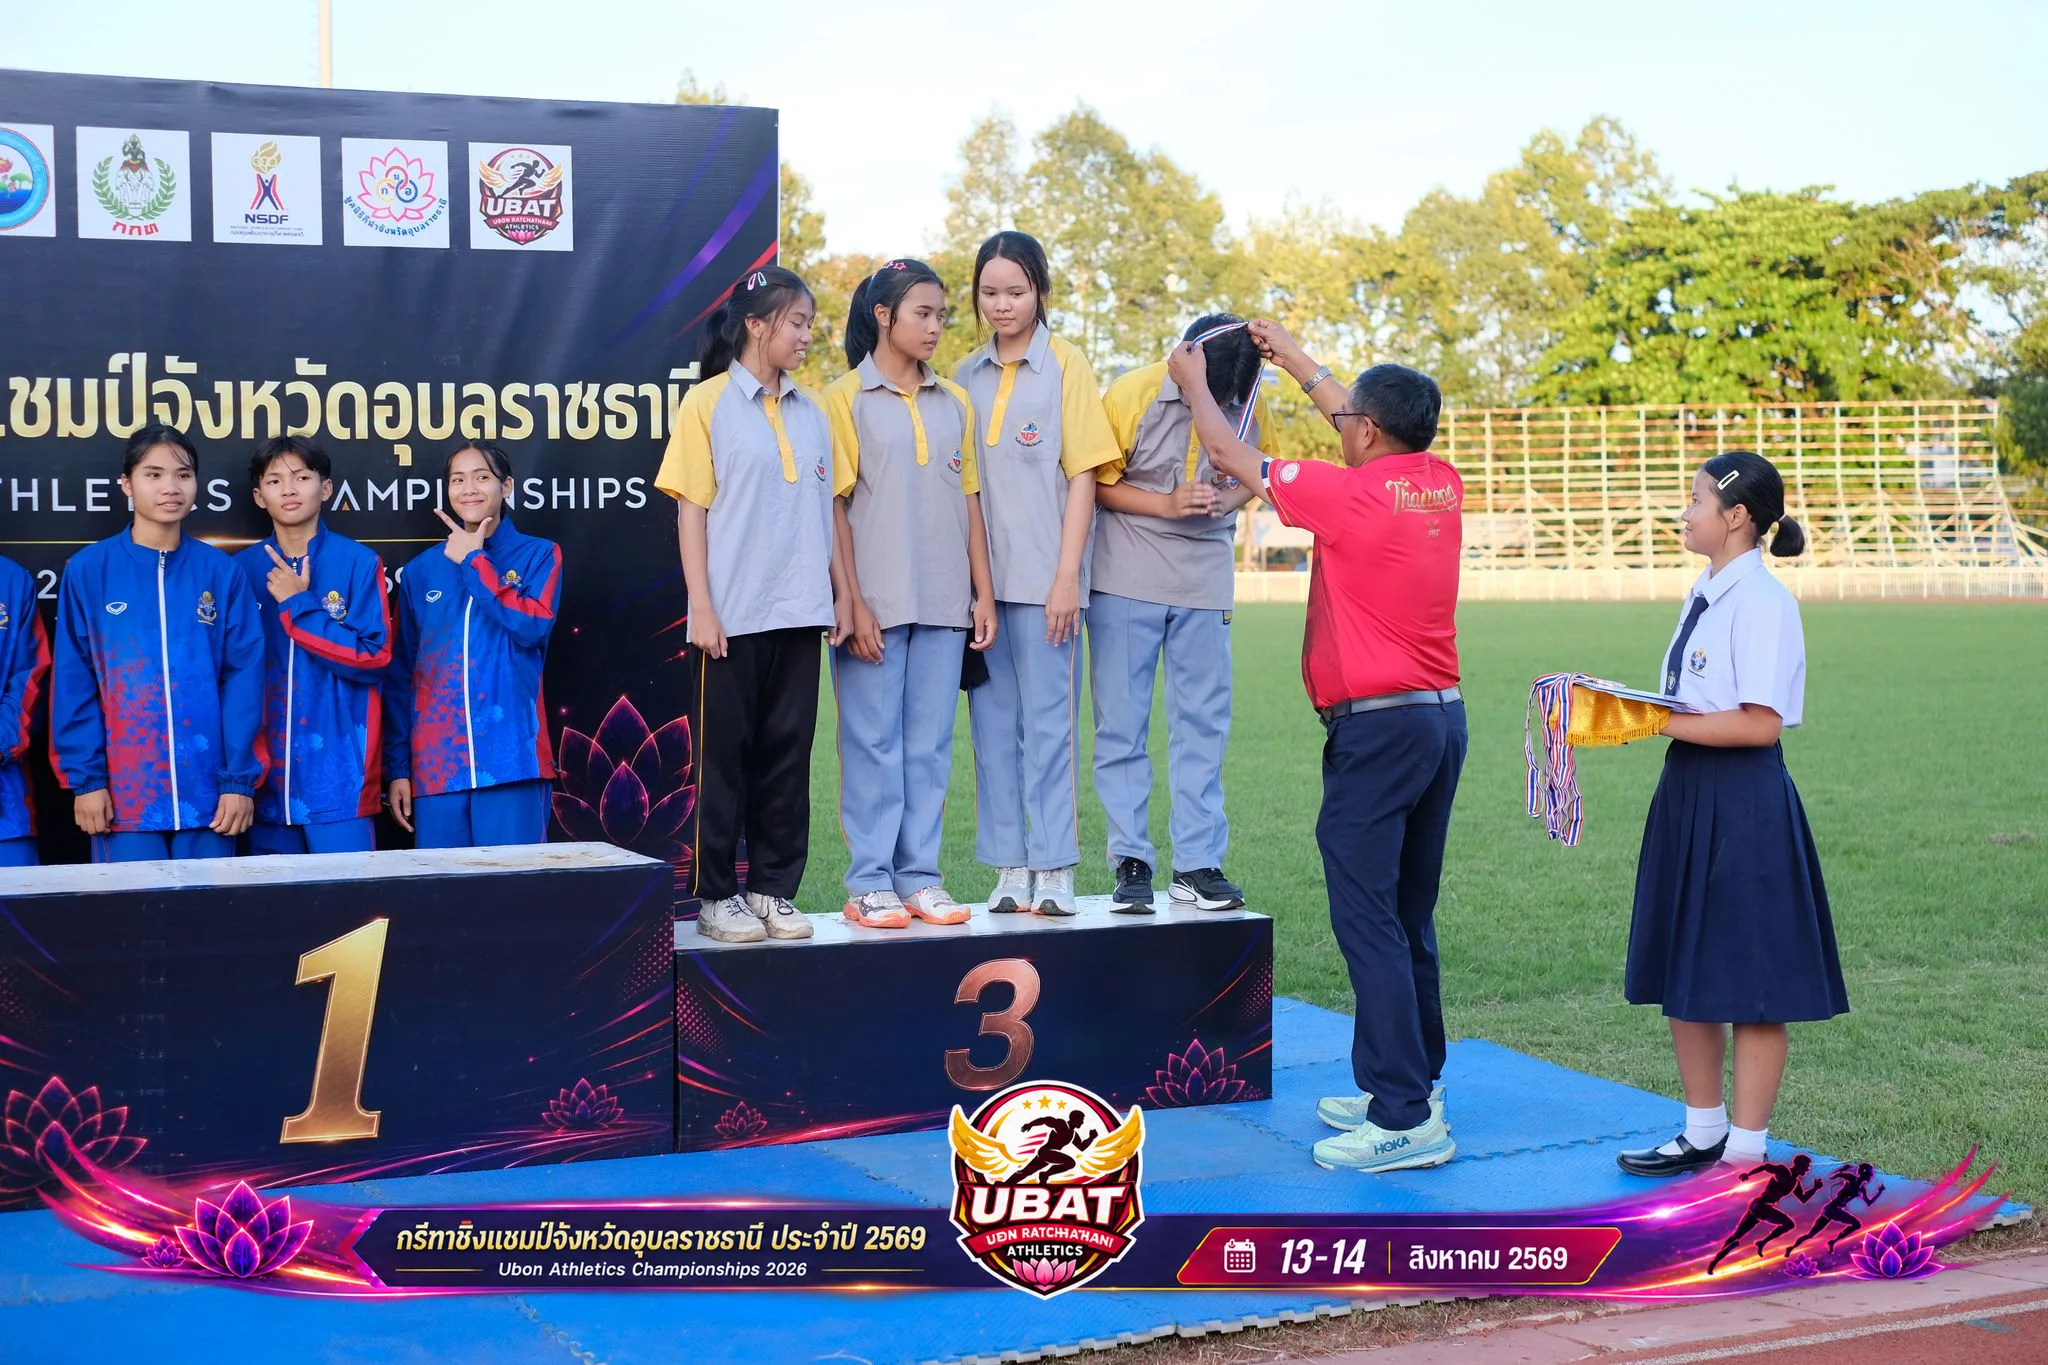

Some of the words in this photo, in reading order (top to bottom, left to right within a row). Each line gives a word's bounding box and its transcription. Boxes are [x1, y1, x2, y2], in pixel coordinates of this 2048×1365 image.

[486, 198, 557, 217] UBAT
[245, 213, 289, 224] NSDF
[279, 918, 389, 1144] 1
[944, 958, 1041, 1091] 3
[1373, 1135, 1411, 1156] HOKA
